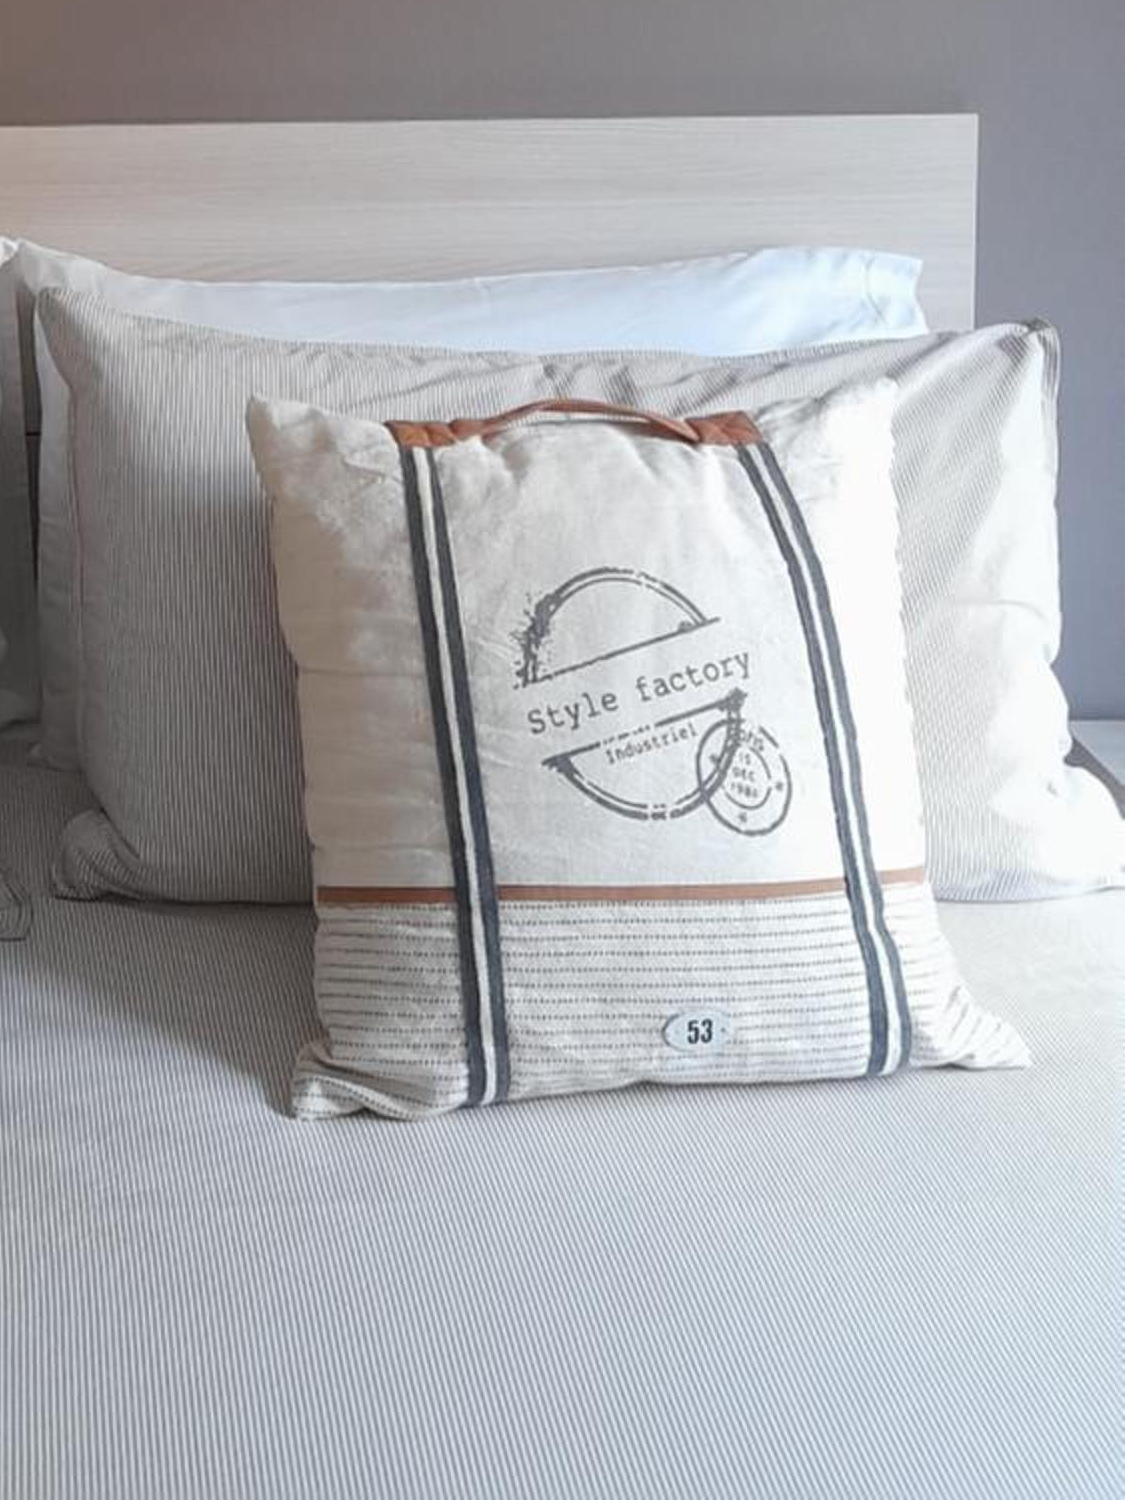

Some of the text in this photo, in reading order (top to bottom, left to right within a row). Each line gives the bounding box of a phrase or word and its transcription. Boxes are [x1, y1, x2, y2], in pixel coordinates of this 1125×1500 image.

[527, 652, 751, 735] Style factory
[604, 722, 698, 764] Industriel
[686, 1017, 714, 1045] 53
